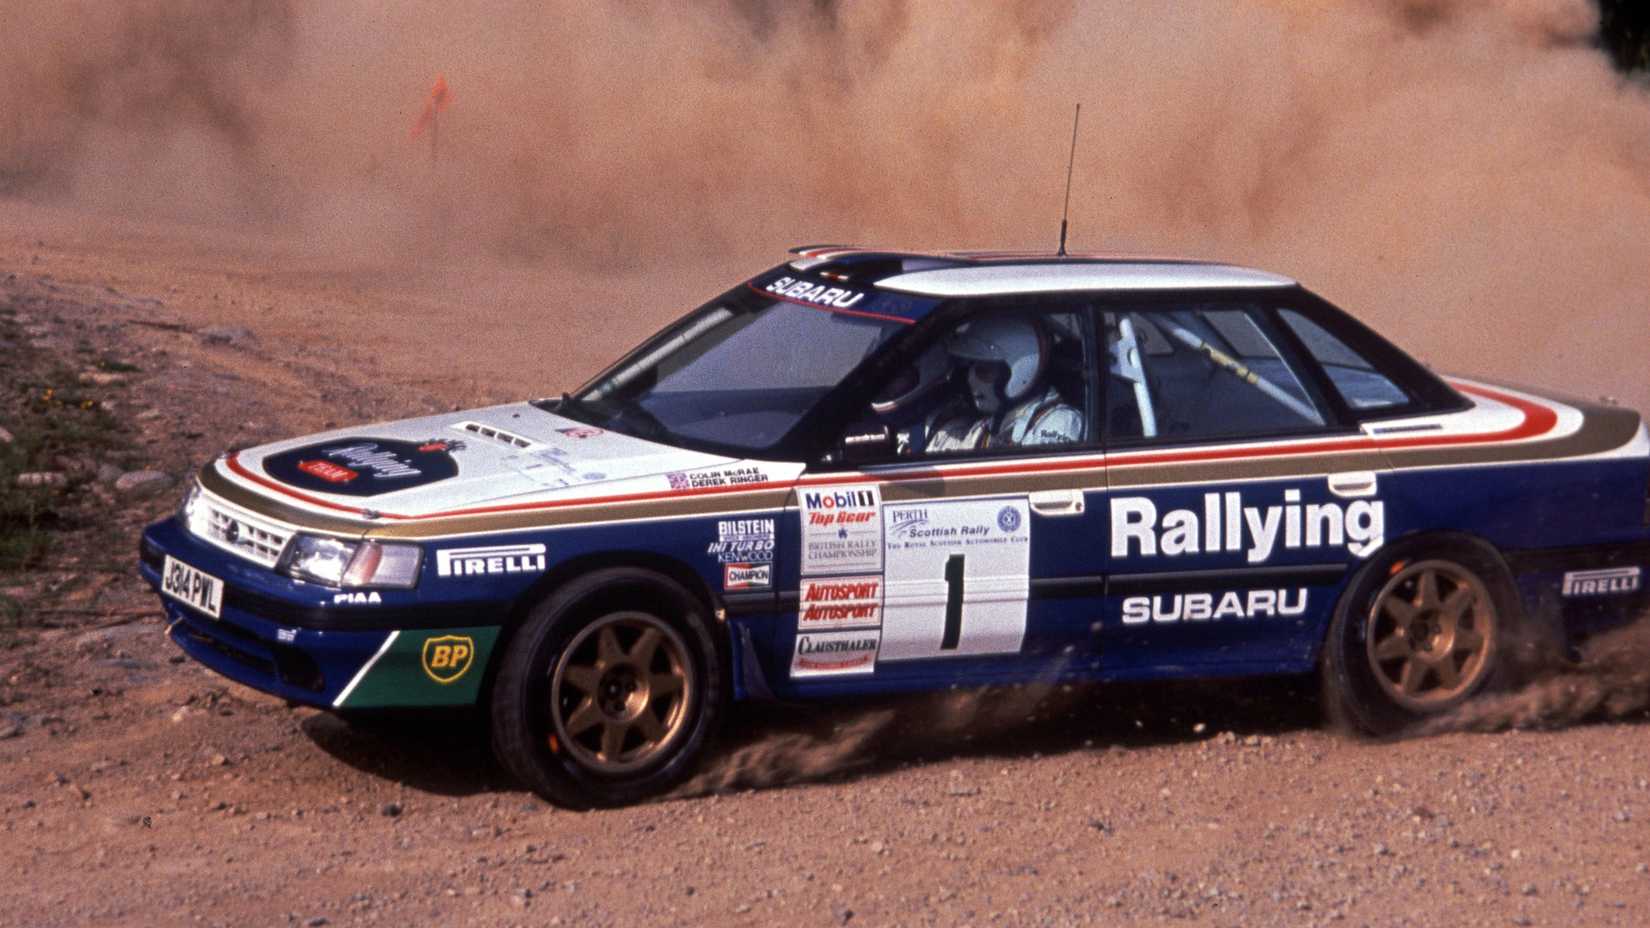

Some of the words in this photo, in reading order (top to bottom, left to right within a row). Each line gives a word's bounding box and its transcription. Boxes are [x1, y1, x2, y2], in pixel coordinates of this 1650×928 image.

[765, 277, 865, 308] SUBARU
[690, 472, 721, 480] COLIN
[723, 467, 760, 477] McRAE
[691, 478, 726, 488] DEREK
[730, 474, 769, 484] RINGER
[805, 490, 857, 509] Mobil
[808, 512, 834, 526] Top
[837, 511, 876, 524] Gear
[893, 509, 928, 522] PERTH
[718, 519, 775, 535] BILSTEIN
[910, 526, 957, 538] Scottish
[960, 525, 991, 537] Rally
[1110, 489, 1384, 562] Rallying
[730, 540, 775, 552] TURBO
[808, 541, 845, 551] BRITISH
[847, 539, 877, 549] RALLY
[436, 543, 546, 576] PIRELLI
[718, 551, 774, 562] KENWOOD
[808, 548, 877, 560] CHAMPIONSHIP
[728, 569, 769, 582] CHAMPION
[1562, 567, 1640, 595] PIRELLI
[333, 591, 382, 604] PIAA
[805, 582, 879, 601] AUTOSPORT
[940, 554, 965, 650] 1
[1121, 588, 1308, 623] SUBARU
[803, 602, 879, 621] AUTOSPORT
[798, 636, 877, 655] CLAUSTHALER
[431, 645, 468, 667] BP
